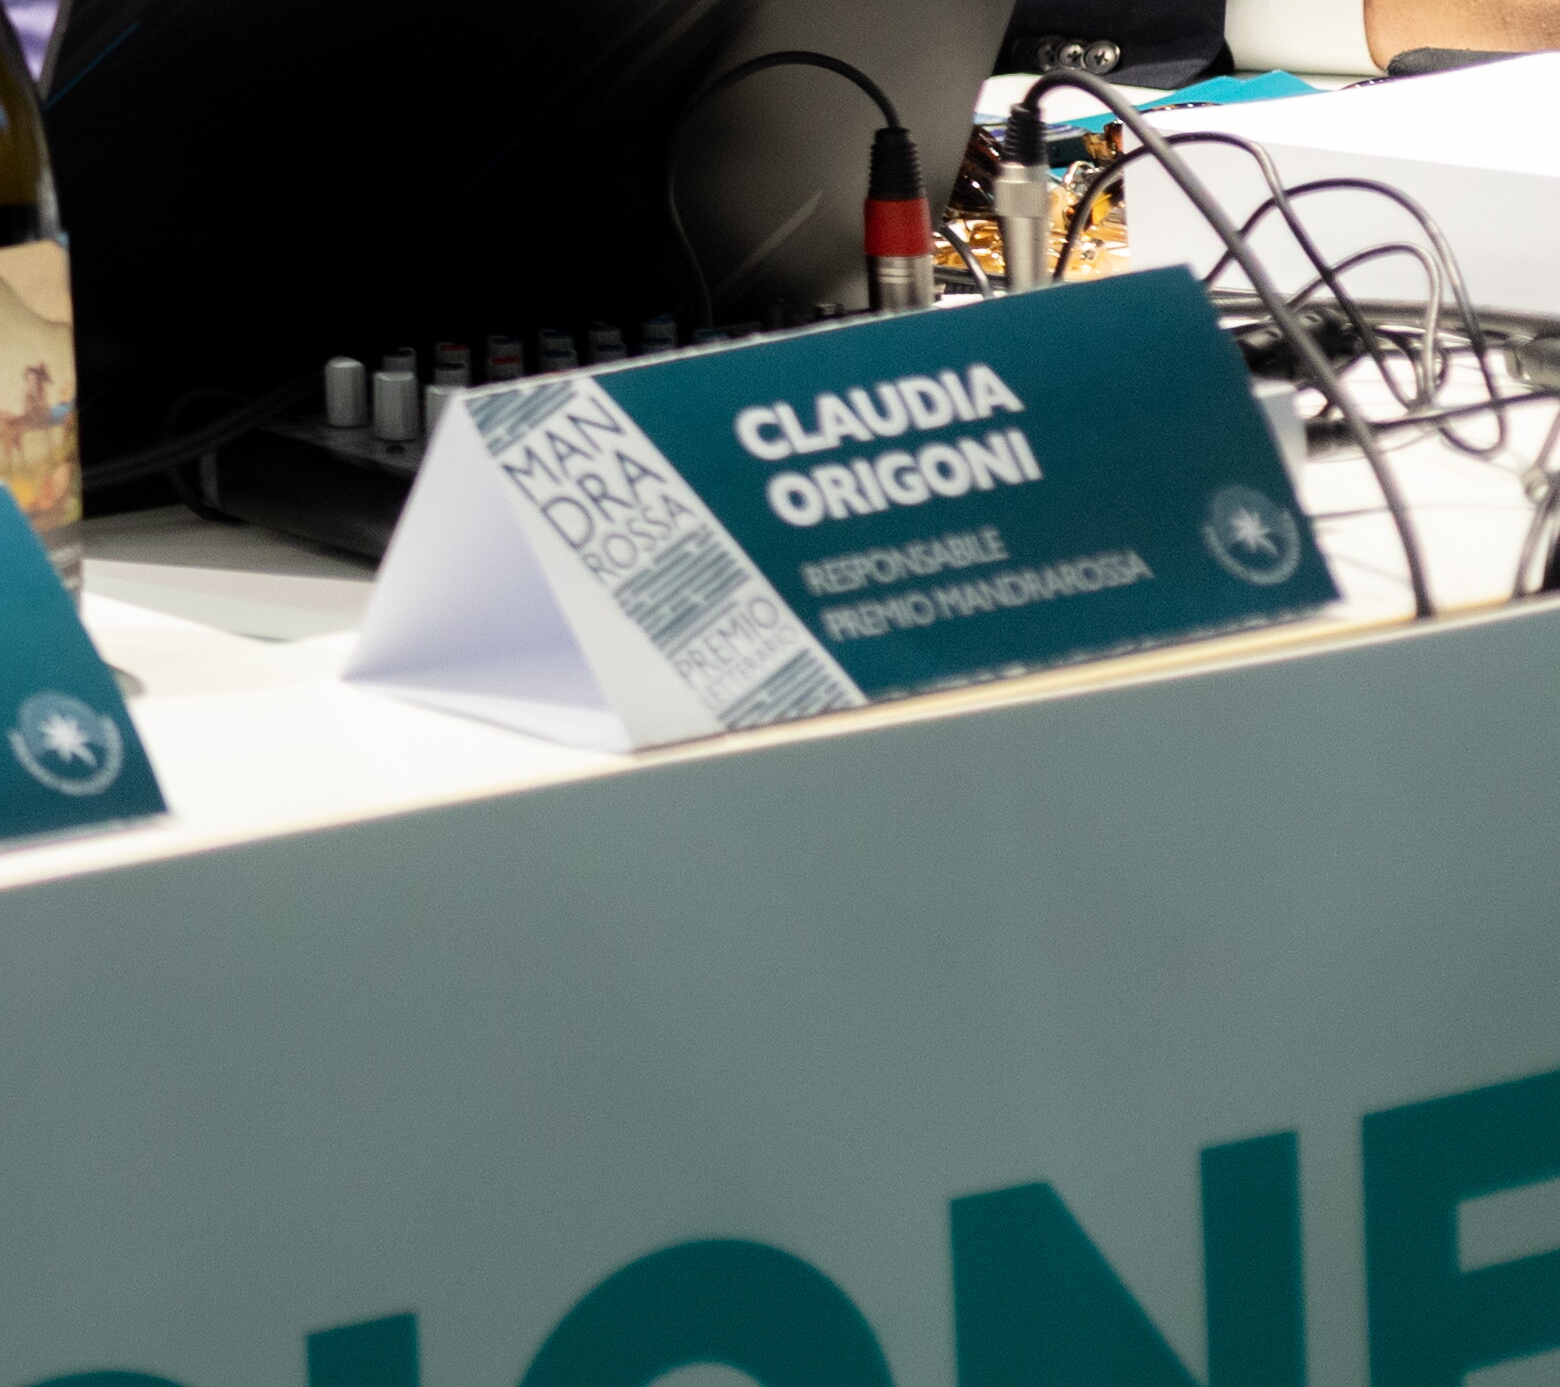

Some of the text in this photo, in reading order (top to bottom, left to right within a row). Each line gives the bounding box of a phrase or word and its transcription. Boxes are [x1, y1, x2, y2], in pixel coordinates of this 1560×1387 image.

[501, 395, 626, 502] MAN
[734, 362, 1025, 461] CLAUDIA
[541, 451, 667, 549] DRA
[767, 428, 1043, 527] ORIGONI
[579, 494, 697, 589] ROSSA
[800, 527, 1010, 596] RESPONSABILE
[673, 596, 780, 689] PREMIO
[822, 549, 1155, 642] PREMIO MANDRAROSSA
